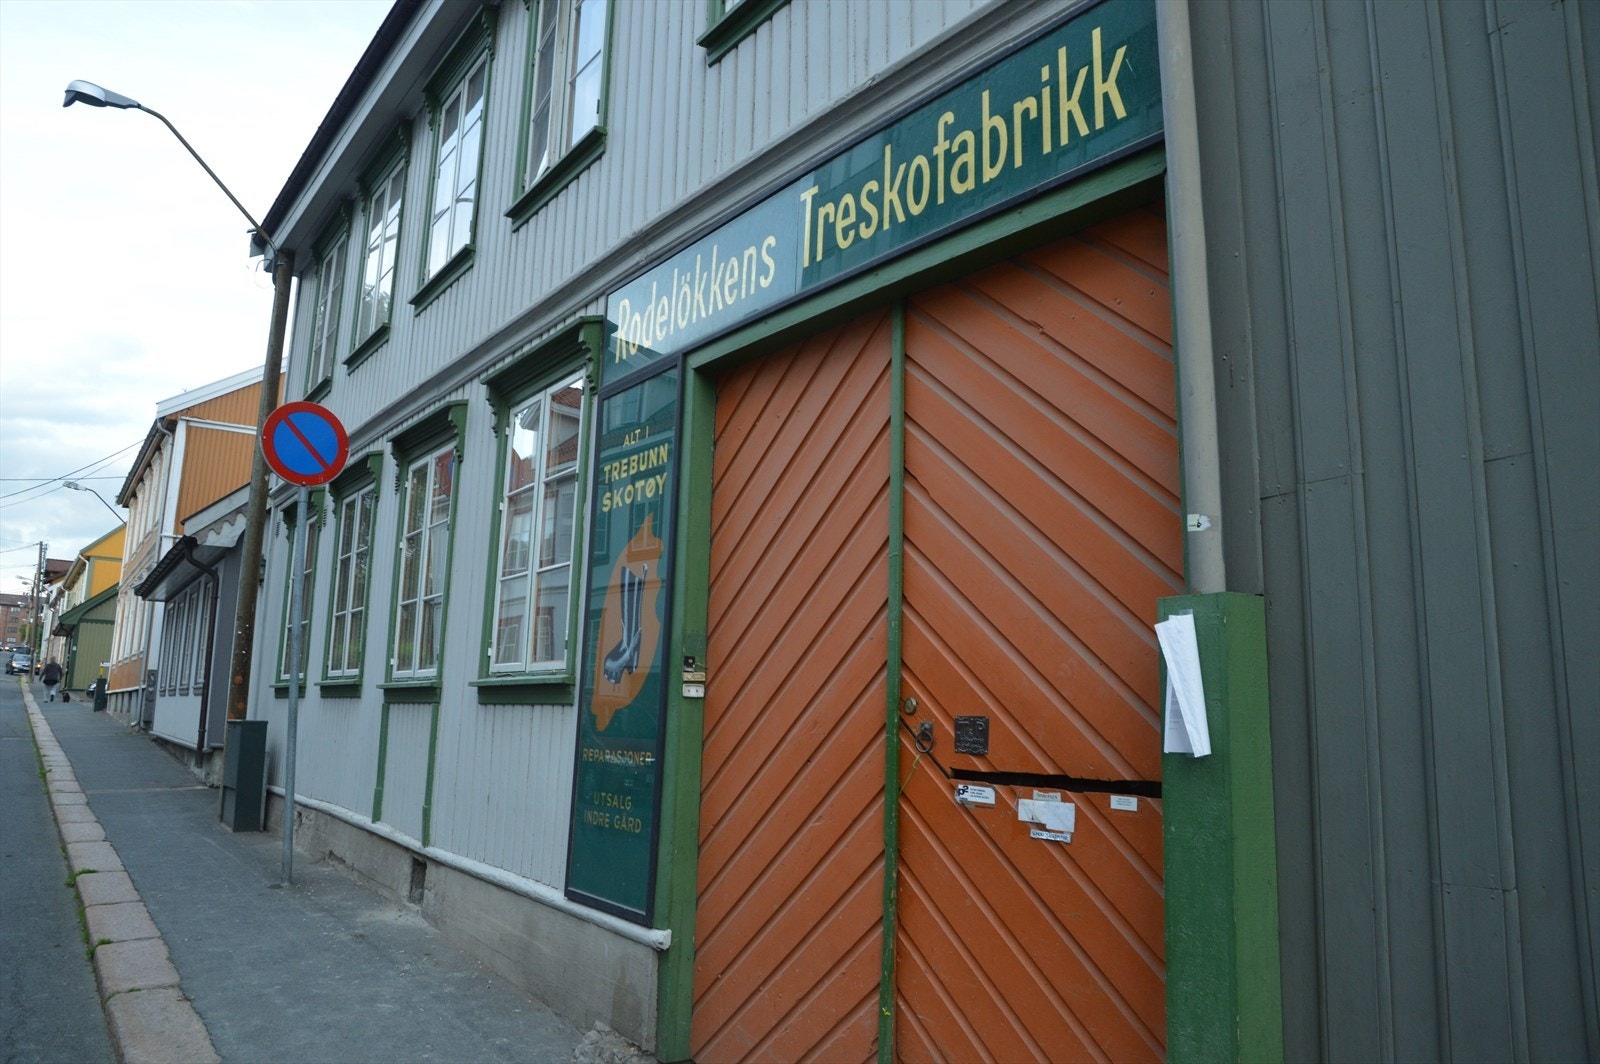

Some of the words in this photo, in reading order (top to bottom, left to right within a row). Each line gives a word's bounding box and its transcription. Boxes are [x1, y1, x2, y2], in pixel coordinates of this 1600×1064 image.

[615, 235, 777, 364] Rodelökkens
[799, 27, 1128, 268] Treskofabrikk
[622, 428, 641, 448] ALT
[645, 425, 649, 439] I
[603, 443, 669, 484] TREBUNN
[601, 472, 668, 513] SKOTØY
[583, 748, 652, 766] REPARASJONER
[593, 791, 632, 811] UTSALG
[584, 808, 610, 828] INDRE
